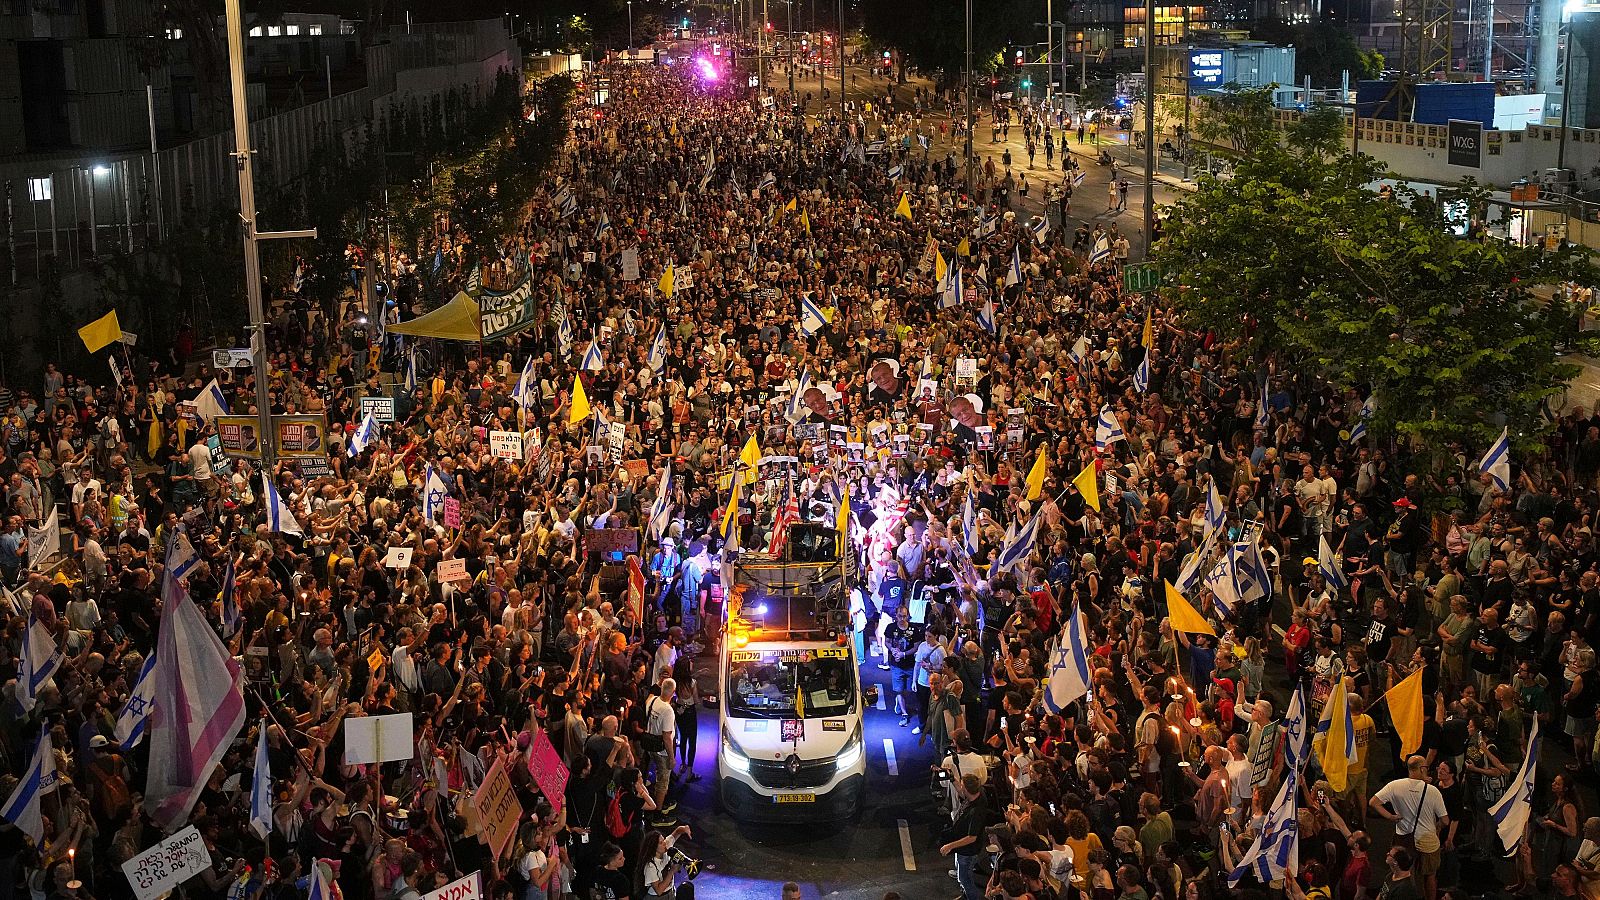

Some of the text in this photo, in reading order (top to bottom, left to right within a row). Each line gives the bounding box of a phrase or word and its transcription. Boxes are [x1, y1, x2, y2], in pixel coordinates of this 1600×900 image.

[734, 652, 760, 660] מלווה
[823, 649, 843, 657] רכב
[165, 848, 188, 863] מוסר
